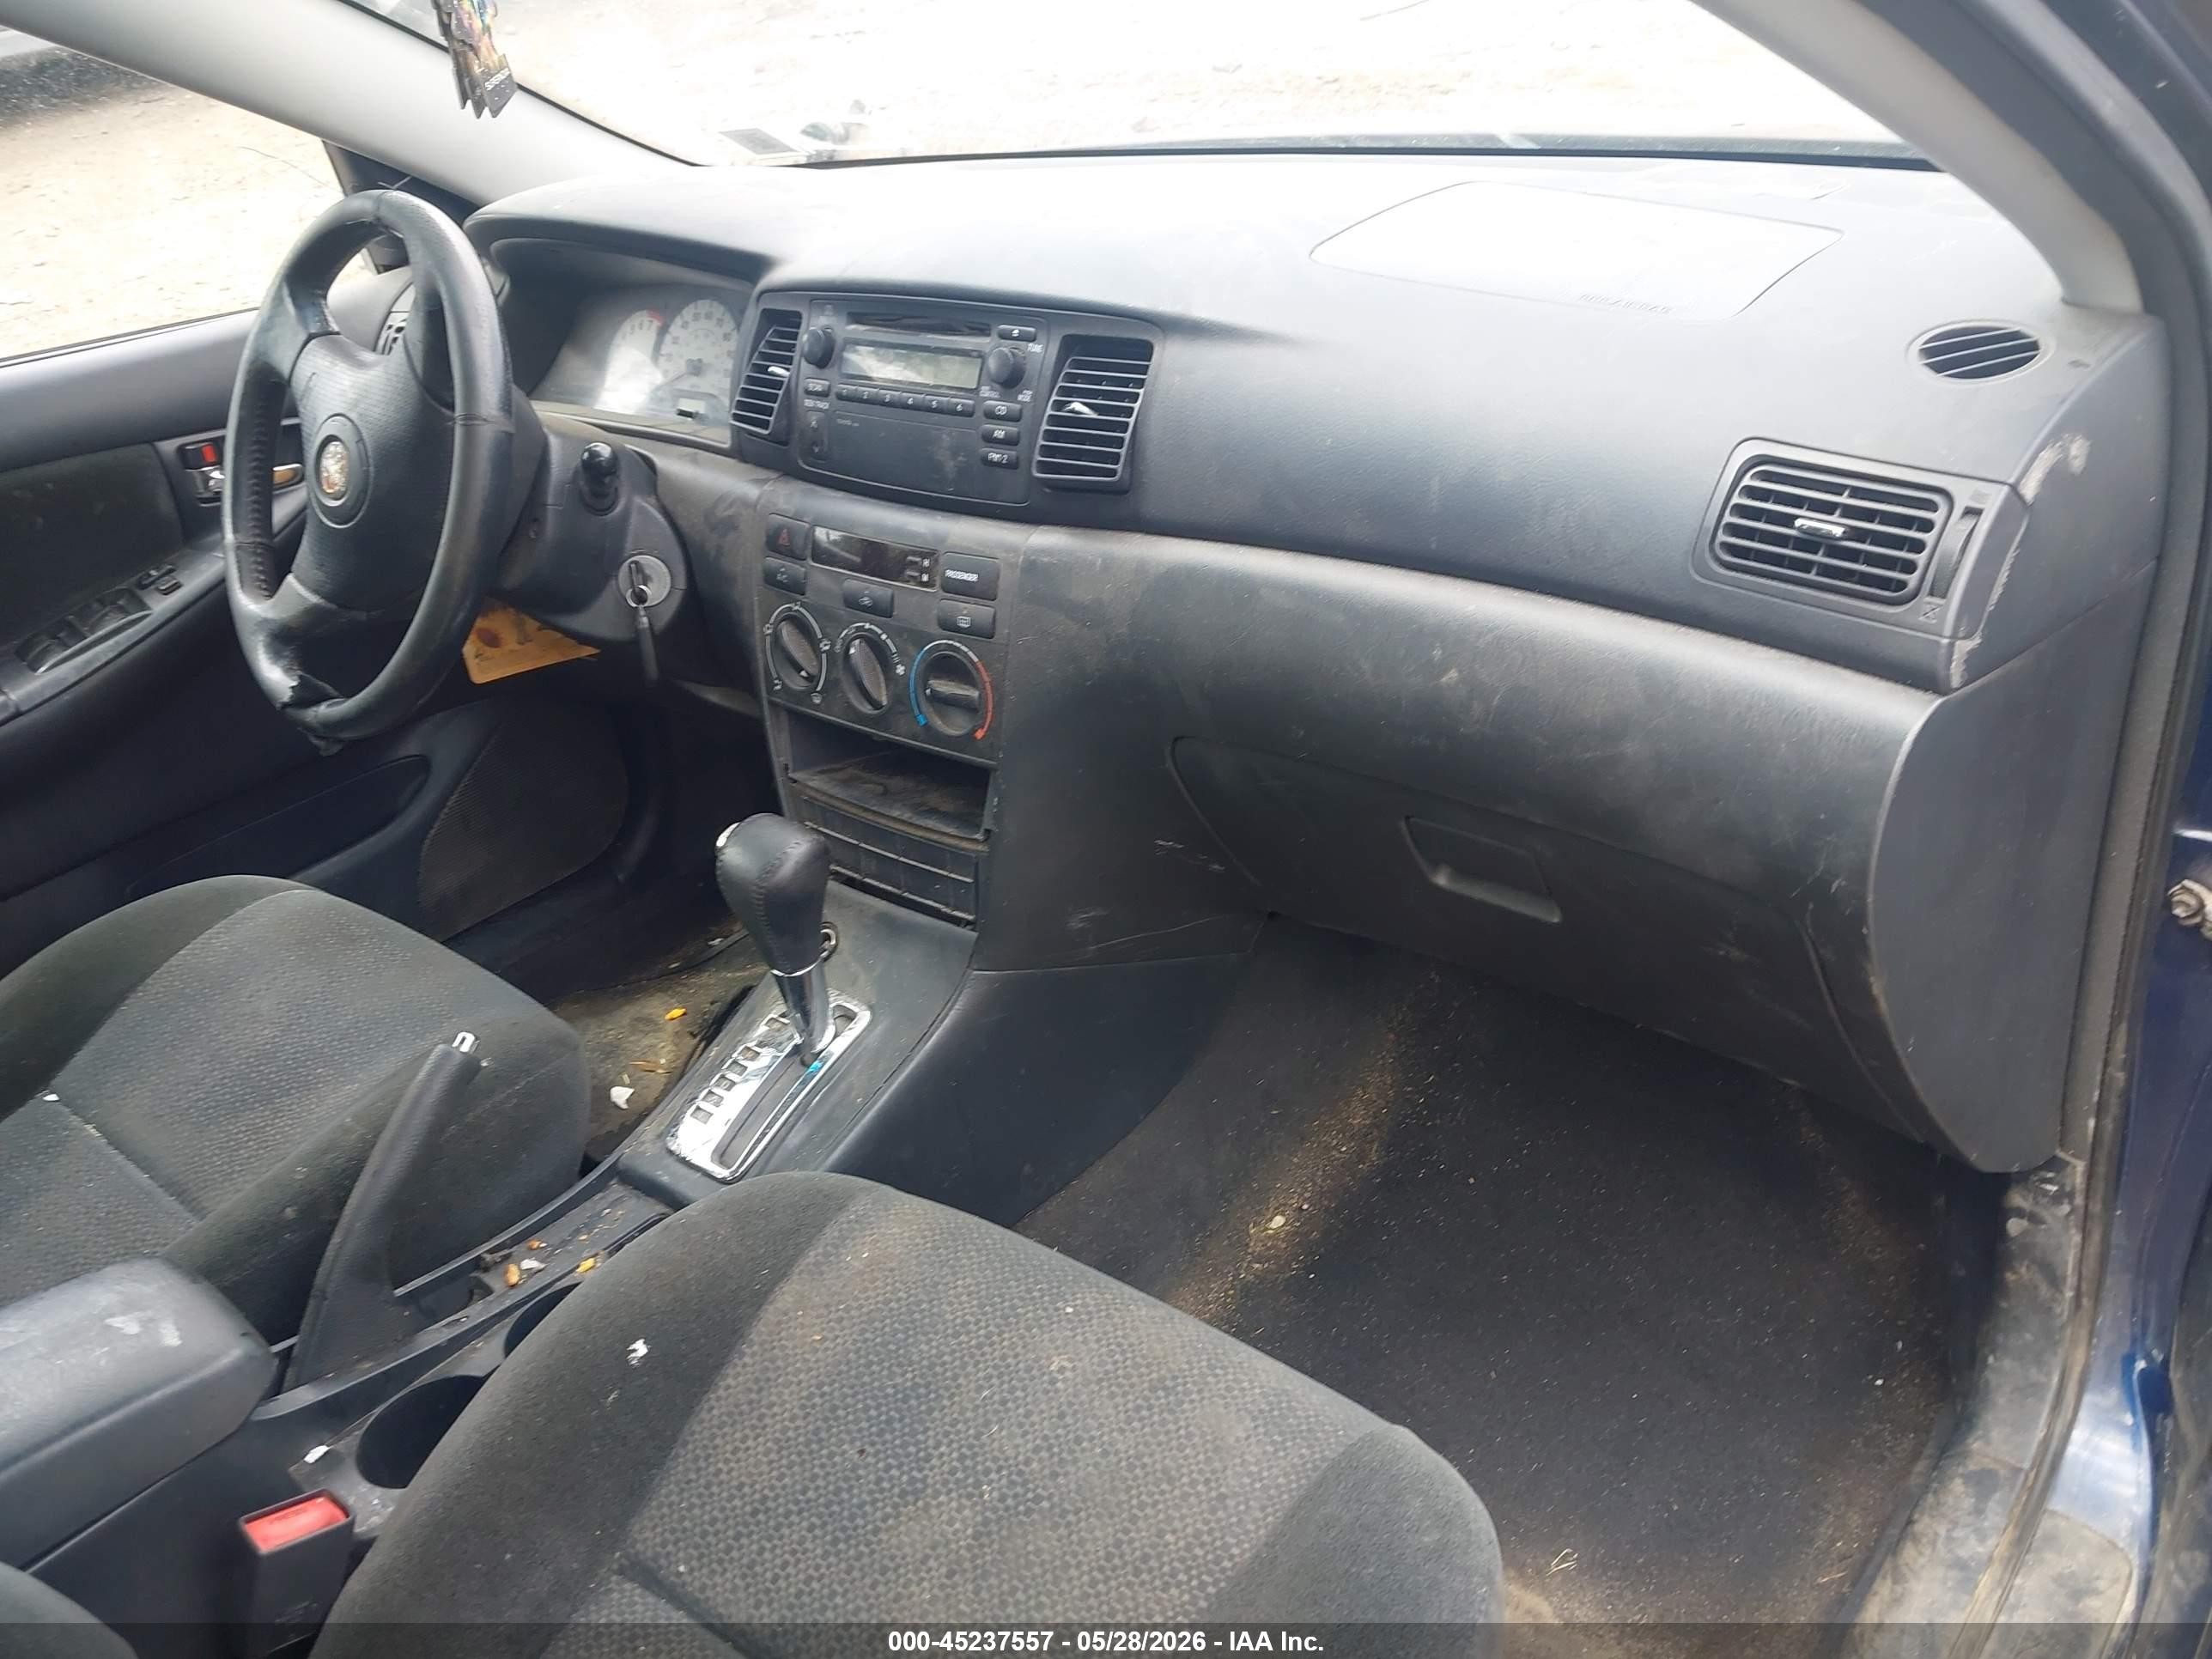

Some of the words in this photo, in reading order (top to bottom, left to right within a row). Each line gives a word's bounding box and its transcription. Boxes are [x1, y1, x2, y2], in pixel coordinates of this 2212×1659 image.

[862, 391, 869, 399] 2
[907, 397, 914, 405] 4
[956, 404, 963, 412] 6
[994, 405, 1007, 416] CD
[992, 429, 1006, 439] AM
